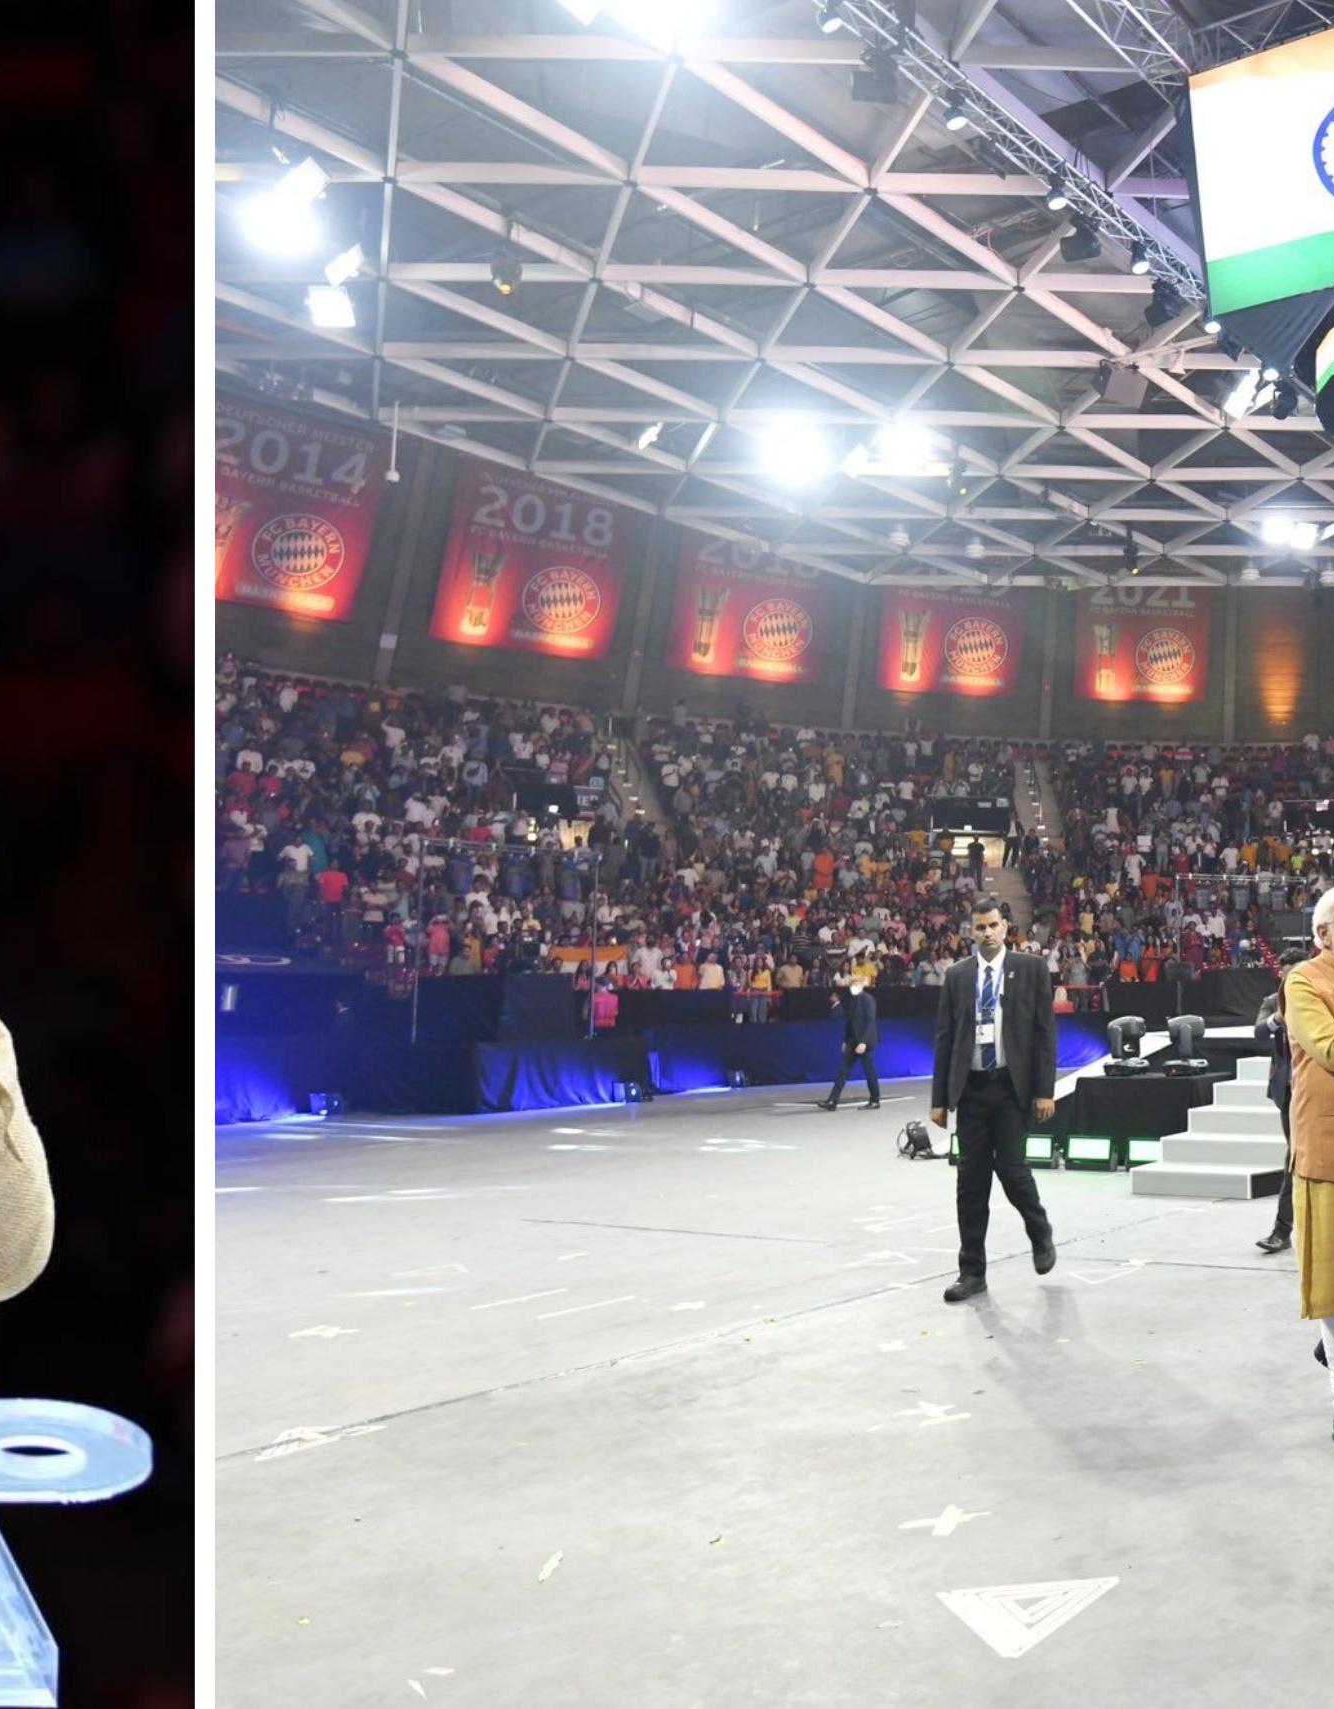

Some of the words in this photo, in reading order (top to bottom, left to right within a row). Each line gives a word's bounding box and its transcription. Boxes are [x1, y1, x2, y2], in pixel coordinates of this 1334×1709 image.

[215, 418, 369, 494] 2014
[220, 466, 275, 487] BAYERN
[278, 481, 360, 507] BASKETBALL
[262, 523, 284, 542] FC
[284, 517, 341, 554] BAYERN
[473, 485, 614, 547] 2018
[550, 570, 597, 601] BAYERN
